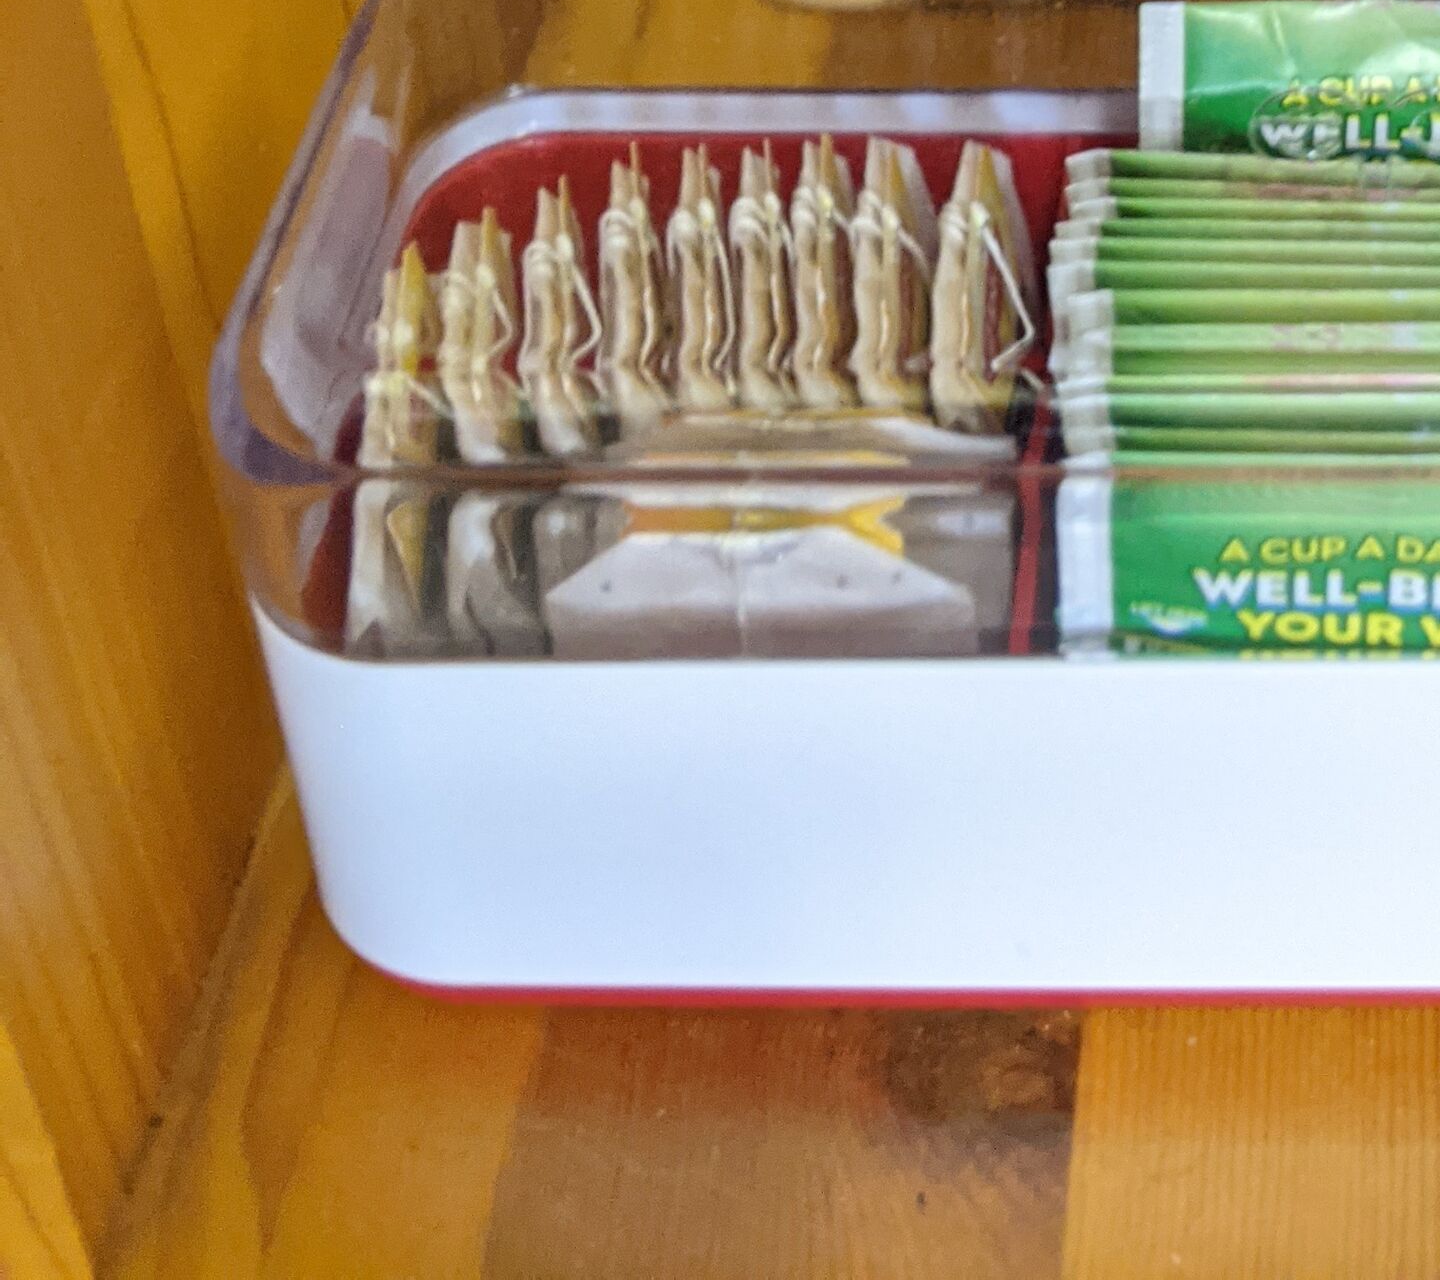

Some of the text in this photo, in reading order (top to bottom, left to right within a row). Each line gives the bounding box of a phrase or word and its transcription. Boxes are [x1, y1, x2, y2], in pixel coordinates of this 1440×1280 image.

[1219, 536, 1251, 565] A
[1259, 536, 1348, 565] CUP
[1355, 535, 1386, 560] A
[1238, 609, 1405, 646] YOUR
